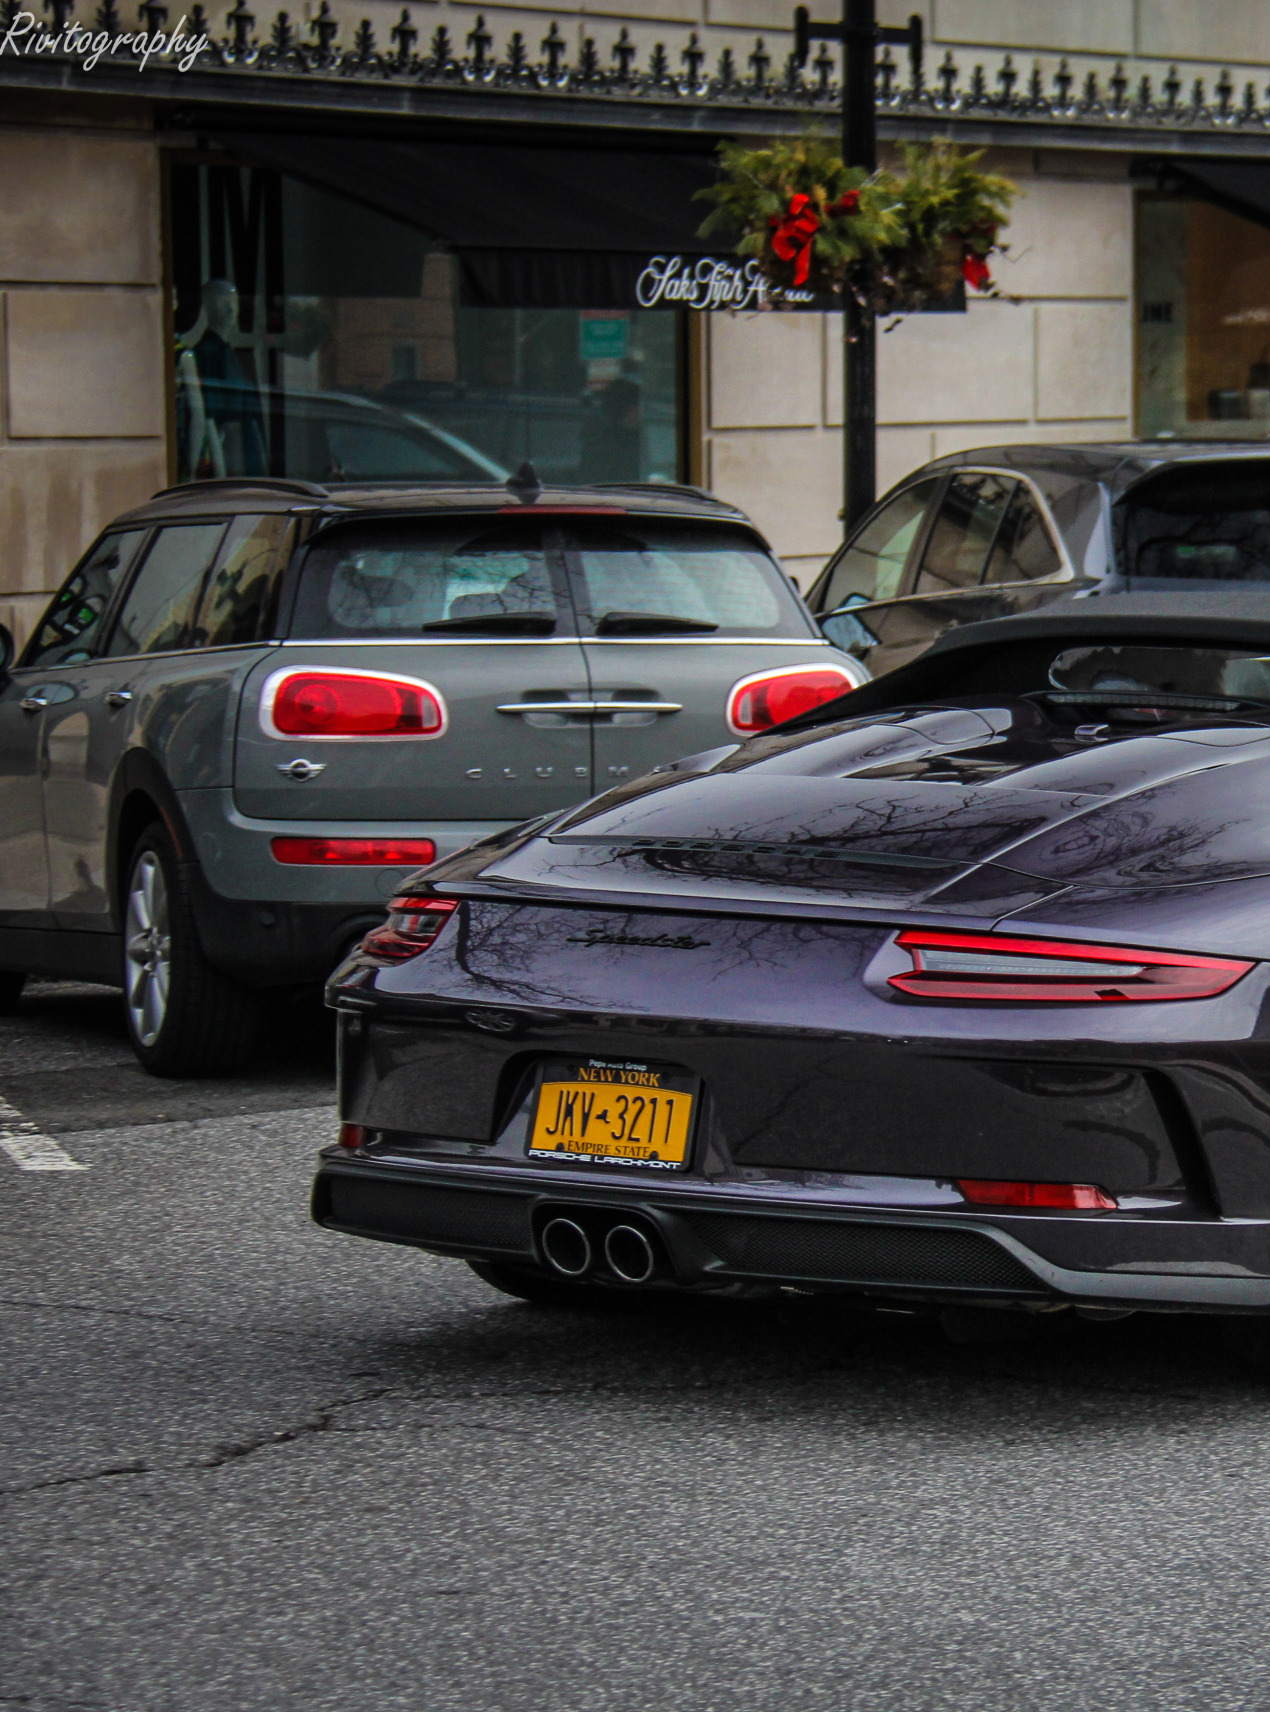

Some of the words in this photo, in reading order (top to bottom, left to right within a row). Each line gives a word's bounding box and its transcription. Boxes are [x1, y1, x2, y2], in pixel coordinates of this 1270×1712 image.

[636, 256, 698, 307] Saks
[465, 766, 661, 779] CLUBM
[566, 928, 711, 950] Speedster
[625, 1062, 647, 1071] Group
[578, 1067, 615, 1082] NEW
[620, 1070, 660, 1087] YORK
[545, 1089, 596, 1138] JKV
[611, 1094, 675, 1144] 3211
[528, 1149, 592, 1162] PORSCHE
[594, 1155, 682, 1170] LARCHMONT
[567, 1140, 611, 1155] EMPIRE
[613, 1145, 650, 1159] STATE
